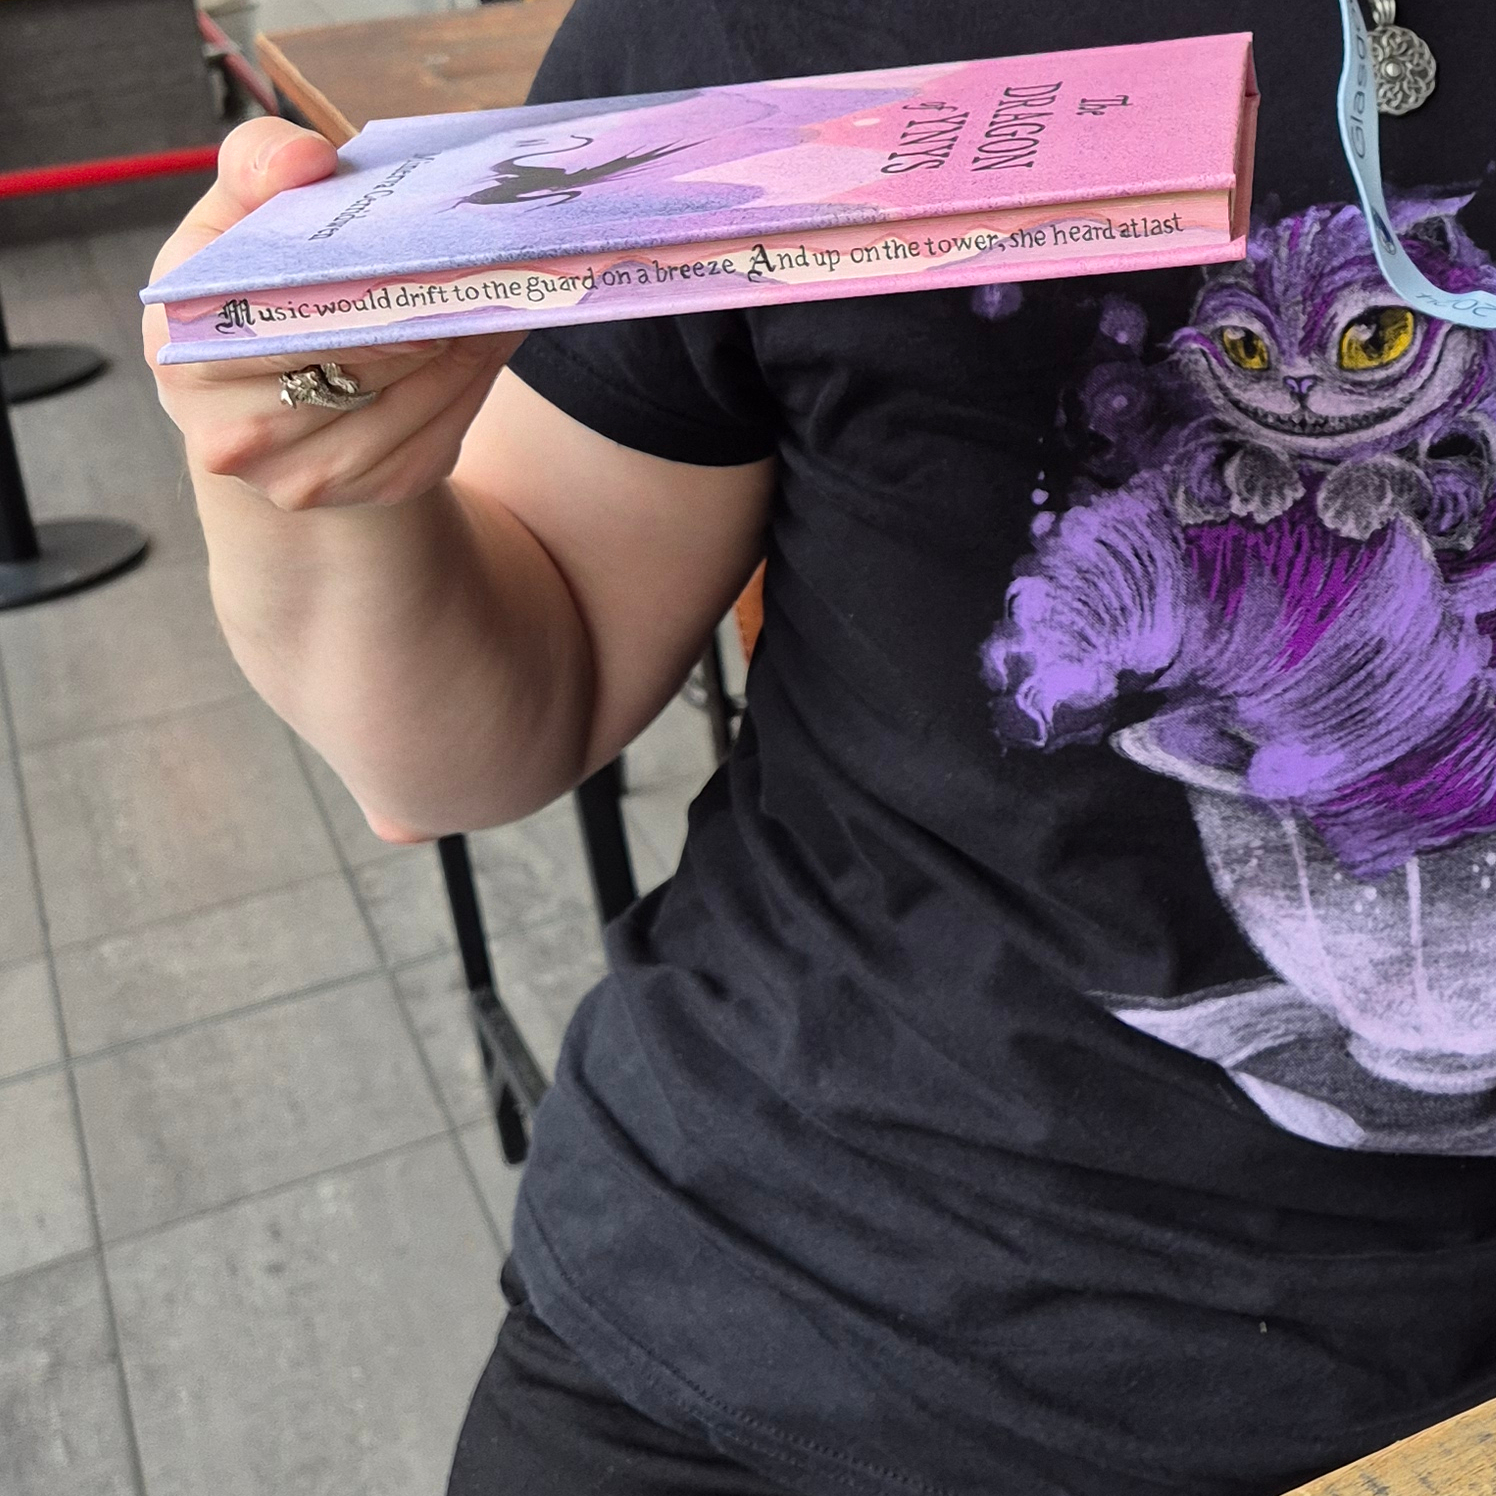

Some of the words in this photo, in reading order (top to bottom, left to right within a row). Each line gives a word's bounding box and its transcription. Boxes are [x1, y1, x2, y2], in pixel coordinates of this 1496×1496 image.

[880, 111, 970, 174] YNYS
[970, 81, 1063, 172] DRAGON
[1076, 94, 1133, 116] The
[215, 298, 311, 335] Music
[310, 288, 392, 319] would
[395, 281, 450, 308] drift
[453, 282, 480, 302] to
[480, 279, 522, 301] the
[526, 267, 596, 302] guard
[602, 269, 630, 287] on
[637, 269, 650, 282] a
[655, 256, 736, 284] breeze
[747, 243, 807, 284] And
[814, 246, 841, 273] up
[850, 243, 880, 264] on
[880, 237, 921, 262] the
[923, 232, 1005, 258] tower,
[1009, 227, 1046, 249] she
[1053, 220, 1116, 246] heard
[1119, 218, 1141, 239] at
[1142, 212, 1184, 237] last
